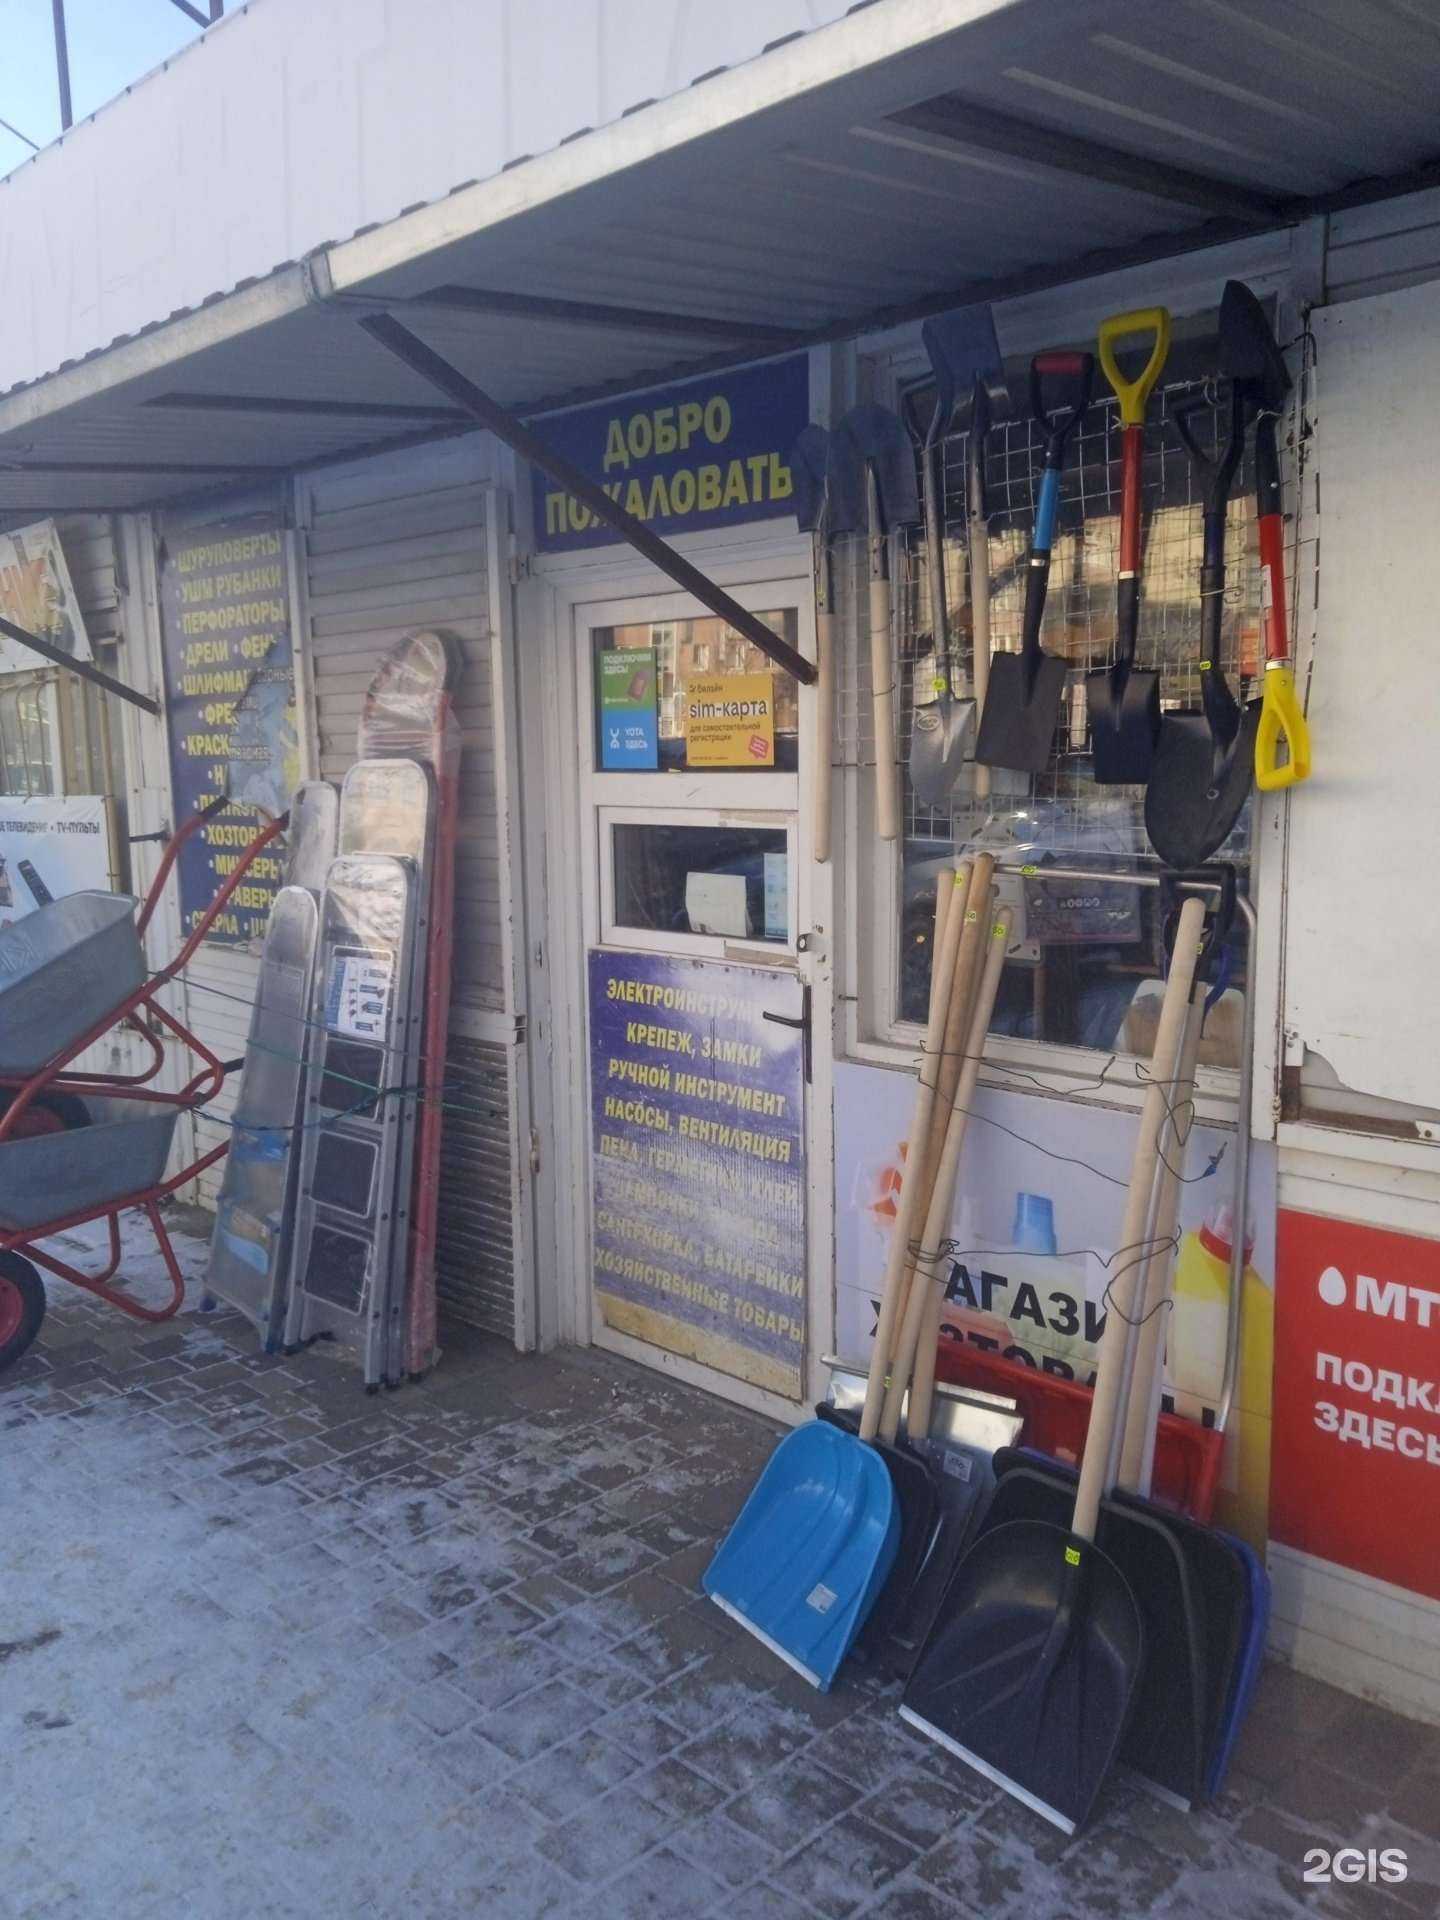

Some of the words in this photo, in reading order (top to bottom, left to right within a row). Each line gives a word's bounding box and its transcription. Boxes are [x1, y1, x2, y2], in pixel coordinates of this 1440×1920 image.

[603, 396, 732, 472] ДОБРО
[216, 565, 281, 597] РУБАНКИ
[184, 599, 284, 634] ПЕРФОРАТОРЫ
[186, 640, 229, 669] ДРЕЛИ
[183, 669, 249, 696] ШЛИФМА
[690, 699, 767, 721] sim-карта
[626, 1022, 696, 1059] КРЕПЕЖ,
[701, 1036, 762, 1068] ЗАМКИ
[608, 1058, 670, 1090] РУЧНОЙ
[675, 1072, 787, 1117] ИНСТРУМЕНТ
[605, 1097, 674, 1136] НАСОСЫ,
[679, 1114, 791, 1163] ВЕНТИЛЯЦИЯ
[594, 1247, 729, 1314] ХОЗЯЙСТВЕННЫЕ
[734, 1297, 804, 1343] ТОВАРЫ
[944, 1263, 1107, 1345] АГАЗИ
[1355, 1274, 1440, 1328] МТ
[1316, 1351, 1440, 1413] ПОДК
